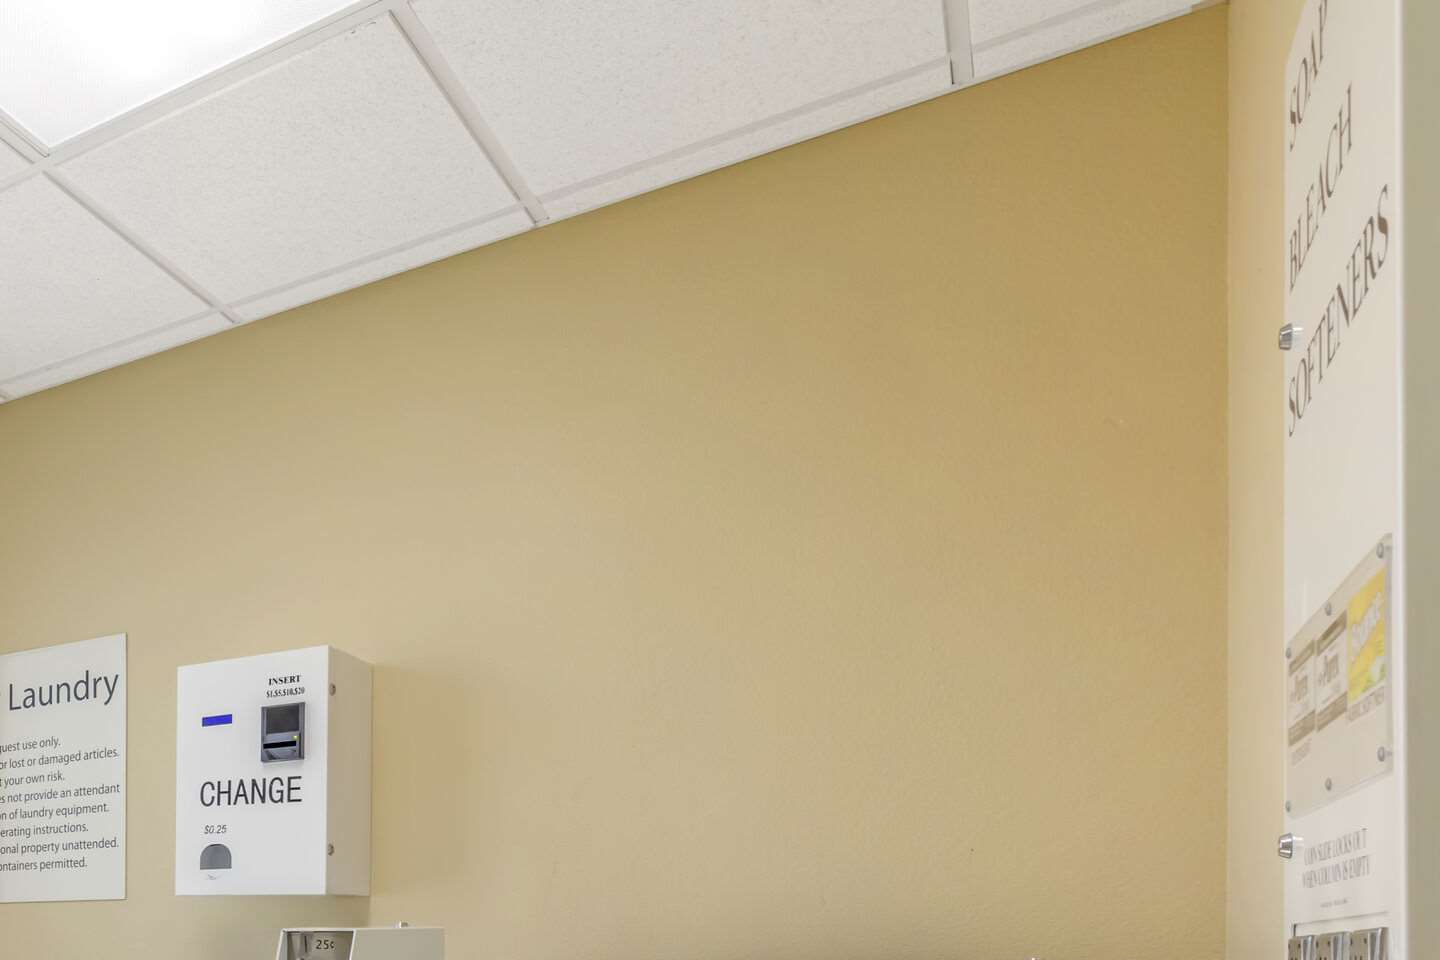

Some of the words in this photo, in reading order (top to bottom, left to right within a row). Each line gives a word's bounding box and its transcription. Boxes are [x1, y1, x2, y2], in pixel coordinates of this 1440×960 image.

[1289, 0, 1328, 152] SOAP
[1288, 81, 1353, 292] BLEACH
[1288, 184, 1390, 438] SOFTENERS
[268, 674, 301, 686] INSERT
[9, 670, 120, 711] Laundry
[22, 740, 38, 750] use
[39, 736, 61, 749] only.
[9, 758, 25, 769] lost
[26, 758, 37, 767] or
[38, 750, 81, 765] damaged
[83, 746, 119, 761] articles.
[4, 775, 23, 789] your
[25, 774, 45, 784] own
[47, 769, 65, 782] risk.
[7, 793, 23, 803] not
[24, 788, 59, 804] provide
[60, 789, 72, 798] an
[73, 783, 120, 797] attendant
[200, 775, 302, 807] CHANGE
[8, 808, 19, 820] of
[20, 806, 54, 820] laundry
[55, 803, 110, 818] equipment.
[33, 822, 89, 836] instructions.
[204, 824, 228, 835] $0.25
[20, 841, 60, 855] property
[61, 836, 119, 852] unattended.
[39, 856, 88, 872] permitted.
[316, 939, 336, 950] 25¢
